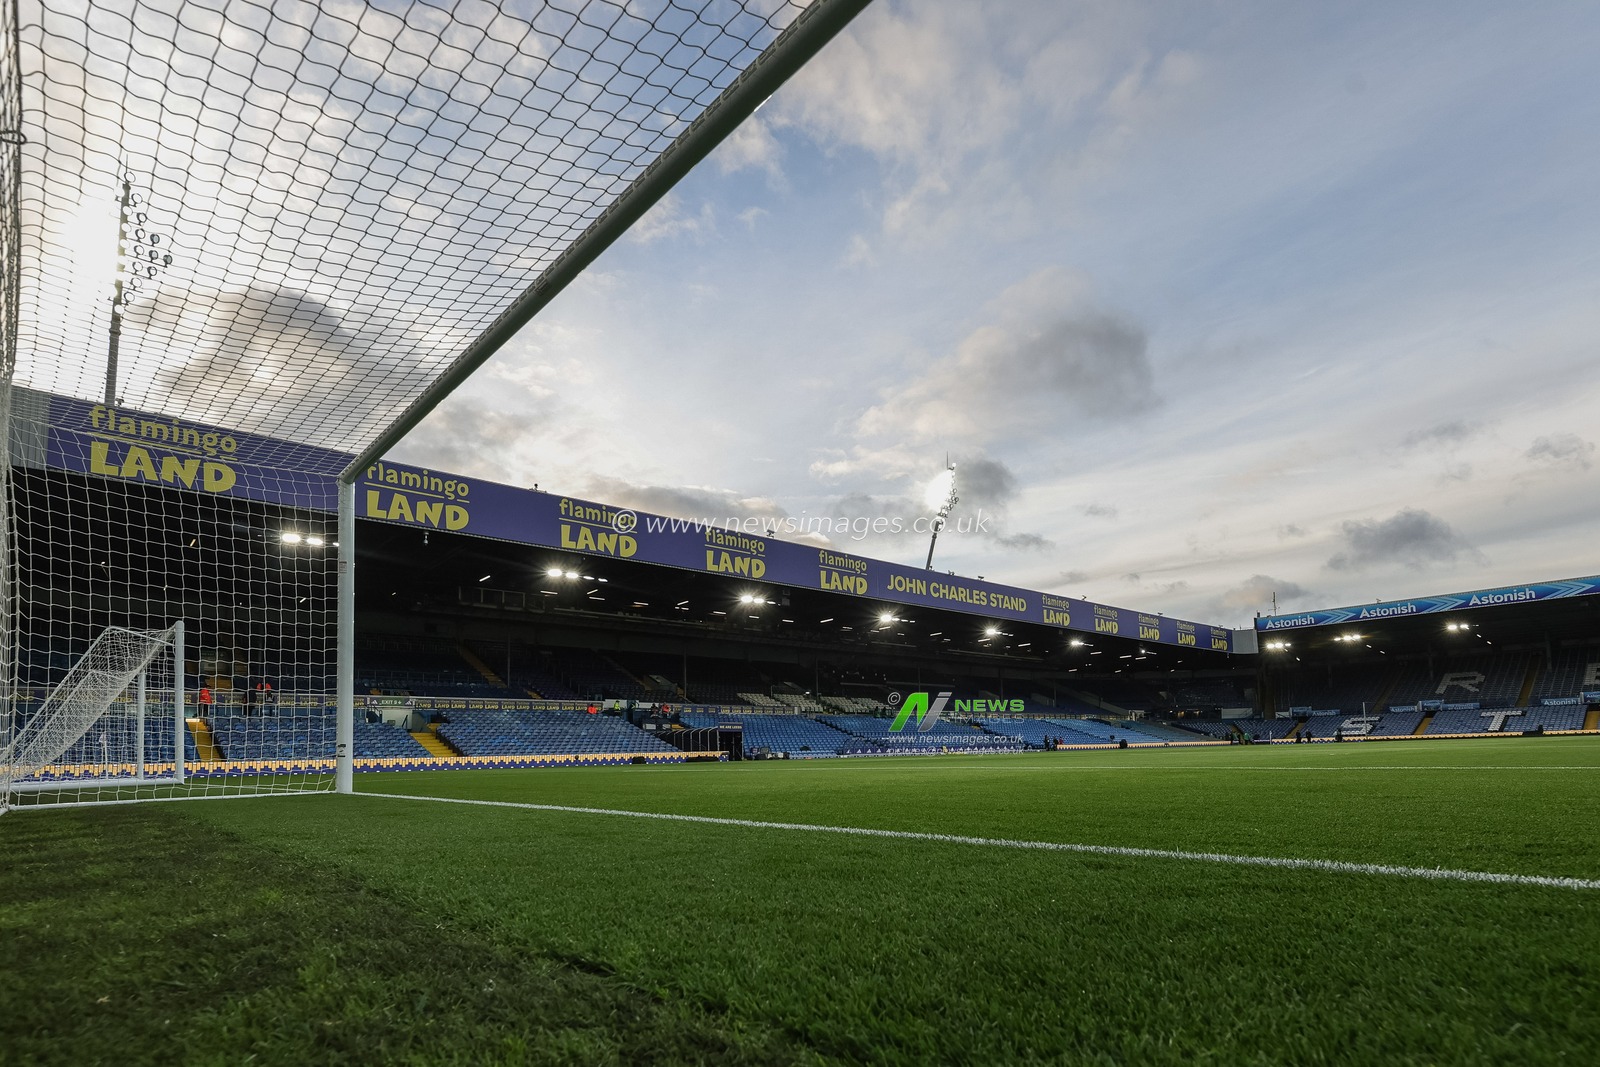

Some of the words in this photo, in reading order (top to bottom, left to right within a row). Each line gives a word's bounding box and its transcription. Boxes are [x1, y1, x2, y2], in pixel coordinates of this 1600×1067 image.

[90, 405, 237, 456] flamingo
[90, 441, 237, 493] LAND
[367, 489, 469, 531] LAND
[561, 524, 637, 558] LAND
[705, 529, 765, 554] flamingo
[707, 550, 766, 579] LAND
[819, 550, 867, 573] flamingo
[820, 570, 868, 595] LAND
[887, 575, 927, 596] JOHN
[930, 582, 988, 605] CHARLES
[990, 593, 1027, 612] STAND
[1042, 594, 1070, 610] flamingo
[1469, 588, 1536, 606] Astonish
[1043, 609, 1071, 627] LAND
[1094, 605, 1118, 619] flamingo
[1359, 603, 1417, 618] Astonish
[1095, 618, 1119, 634] LAND
[1265, 615, 1315, 629] Astonish
[1139, 626, 1160, 641] LAND
[1178, 632, 1196, 646] LAND
[1211, 638, 1228, 651] LAND
[1544, 698, 1577, 706] Astonish
